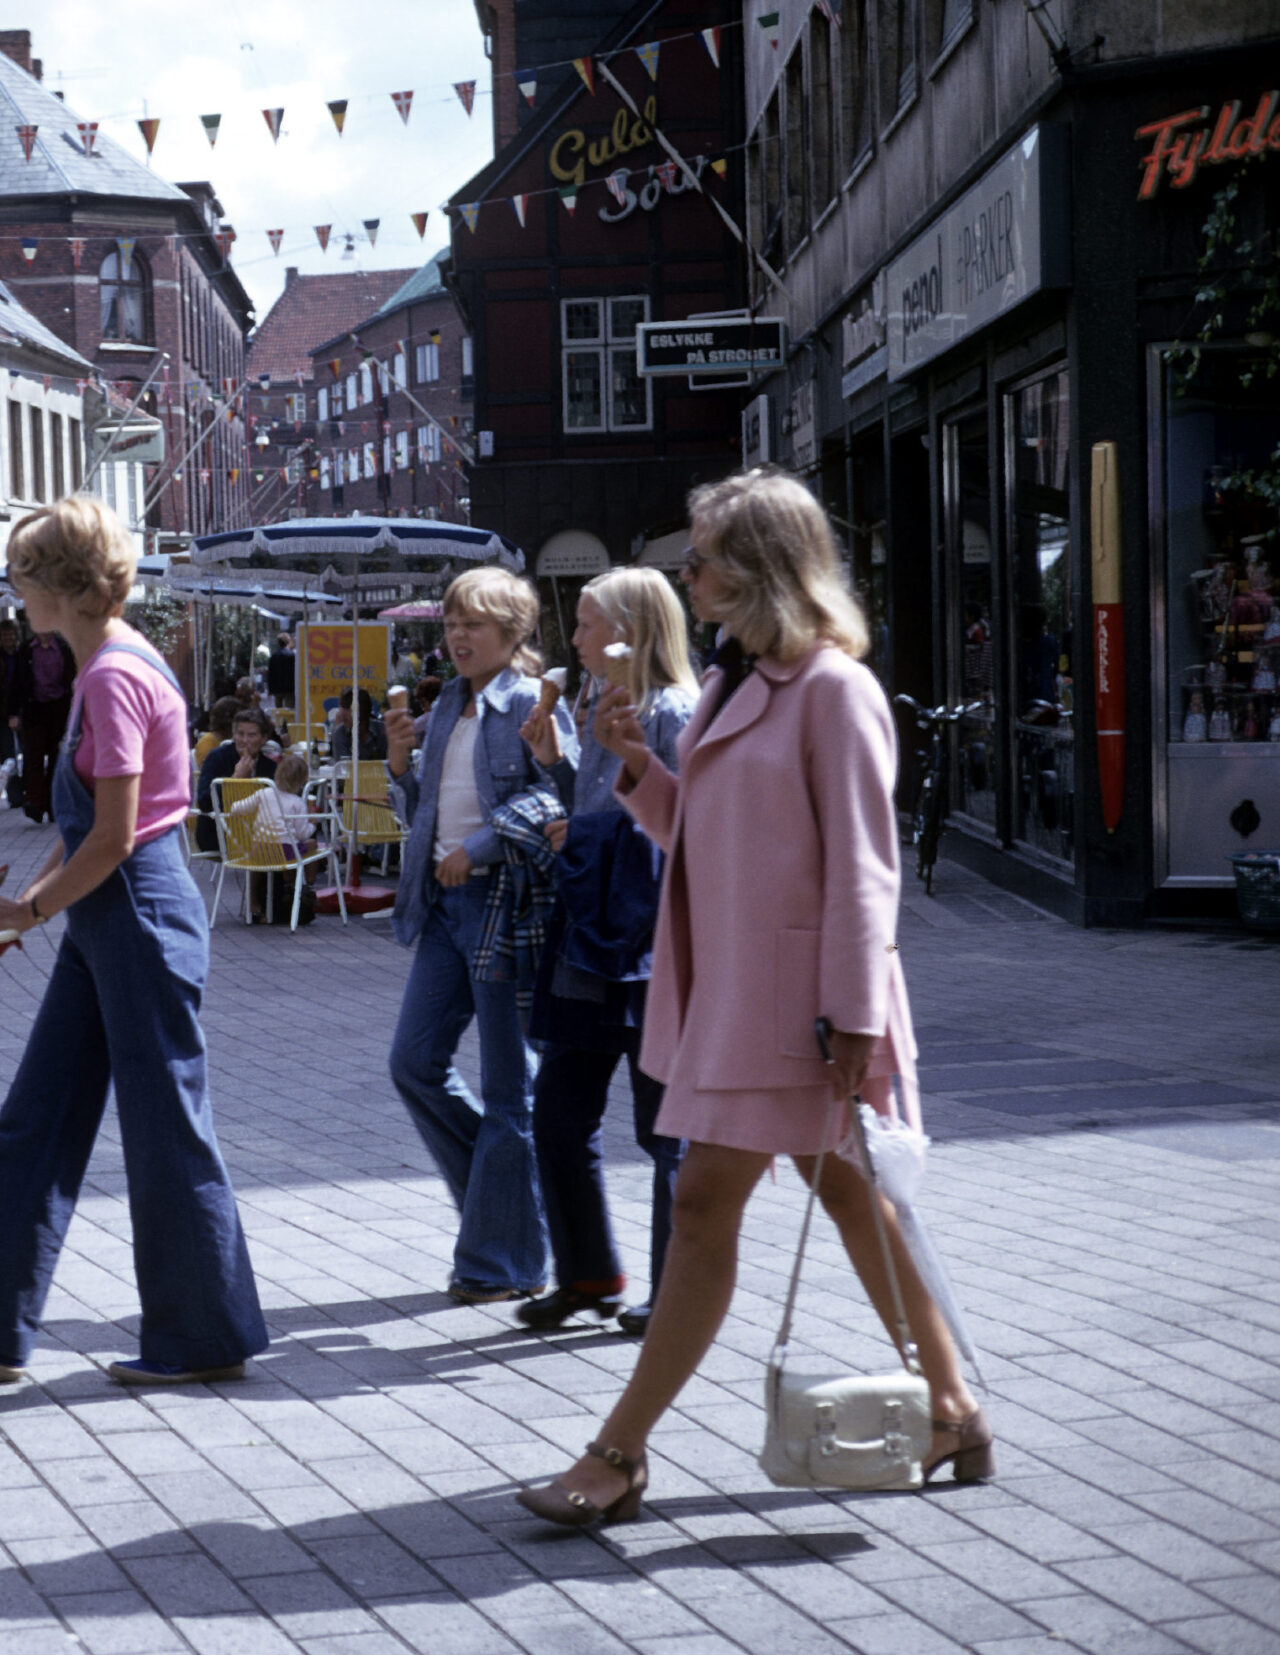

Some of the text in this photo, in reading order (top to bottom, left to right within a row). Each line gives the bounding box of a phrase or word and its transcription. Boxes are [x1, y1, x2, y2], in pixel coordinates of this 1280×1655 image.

[549, 95, 657, 187] Guld
[963, 191, 1015, 305] PARKER
[902, 233, 943, 364] penol
[686, 349, 706, 363] PÅ
[308, 630, 354, 664] SE
[1098, 610, 1110, 693] PARKER
